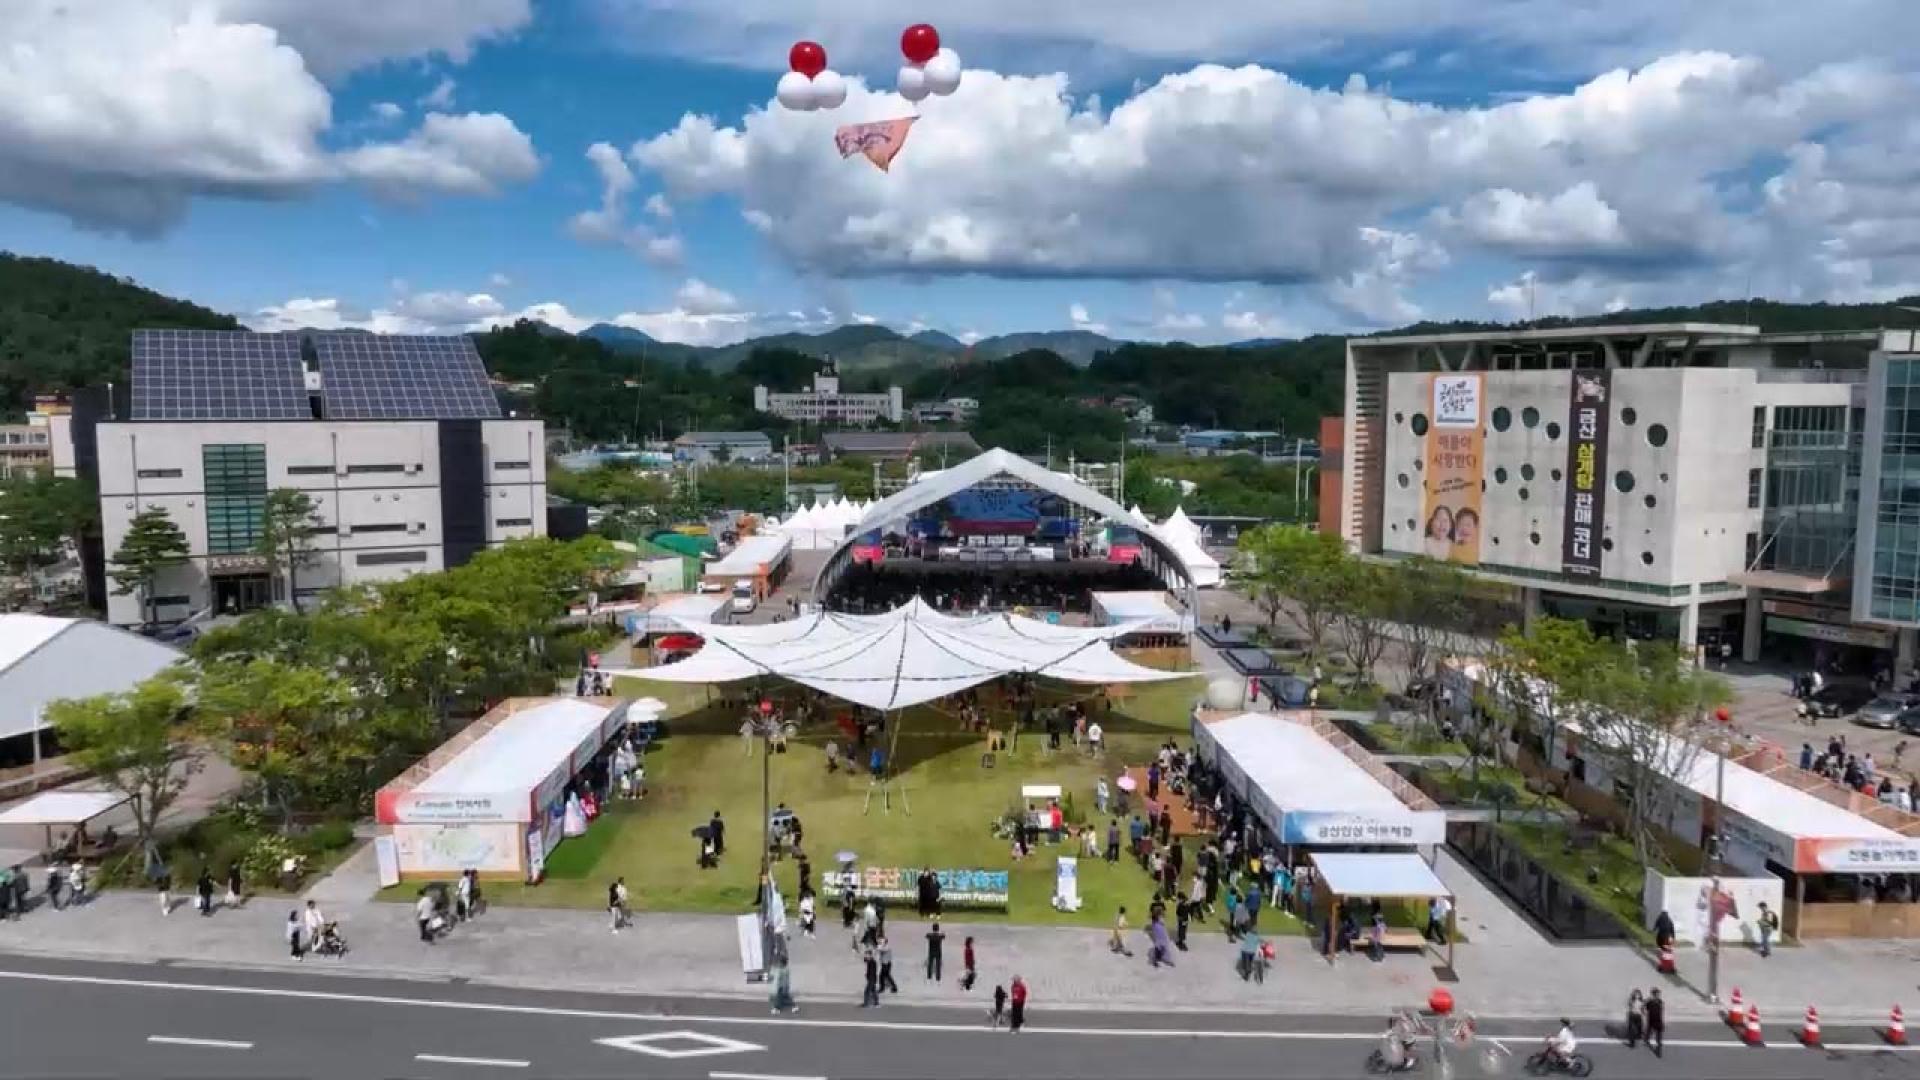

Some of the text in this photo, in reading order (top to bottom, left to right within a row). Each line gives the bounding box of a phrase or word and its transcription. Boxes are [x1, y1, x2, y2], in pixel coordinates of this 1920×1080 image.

[1578, 408, 1596, 439] 금산
[1575, 443, 1596, 490] 삼계탕
[1573, 493, 1593, 524] 판매
[1572, 527, 1591, 559] 코너
[1319, 825, 1363, 838] 금산인삼
